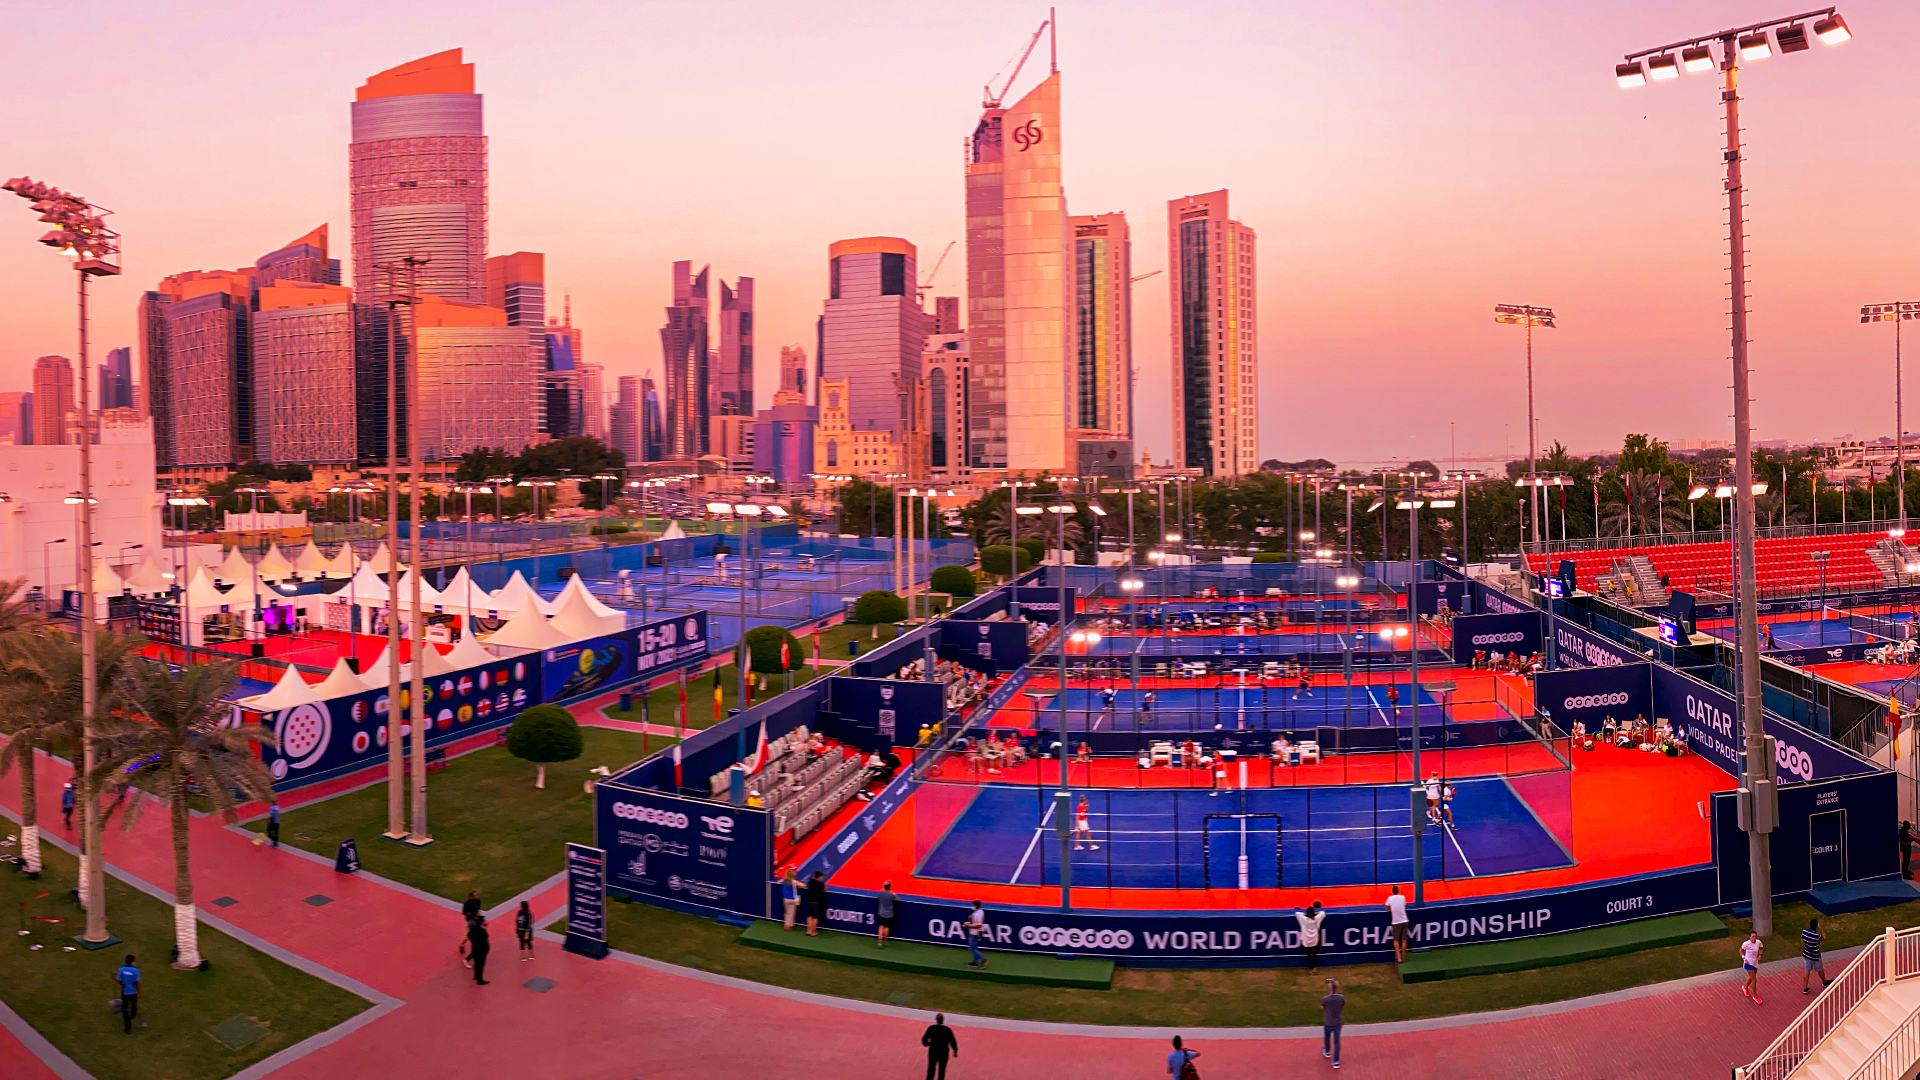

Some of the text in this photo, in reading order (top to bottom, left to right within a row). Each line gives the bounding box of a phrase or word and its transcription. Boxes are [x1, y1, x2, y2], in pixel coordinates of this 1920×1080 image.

[1472, 632, 1524, 645] ooredoo
[1558, 629, 1583, 657] QATAR
[1564, 692, 1629, 710] ooredoo
[1686, 695, 1732, 739] QATAR
[1688, 724, 1713, 748] WORLD
[612, 802, 689, 829] ooredoo
[1814, 845, 1833, 854] COURT
[1606, 895, 1653, 914] COURT 3
[826, 908, 875, 925] COURT 3
[928, 919, 1012, 943] QAAR
[1019, 925, 1134, 949] ooredoo
[1143, 931, 1242, 949] WORLD
[1250, 929, 1334, 949] PADL
